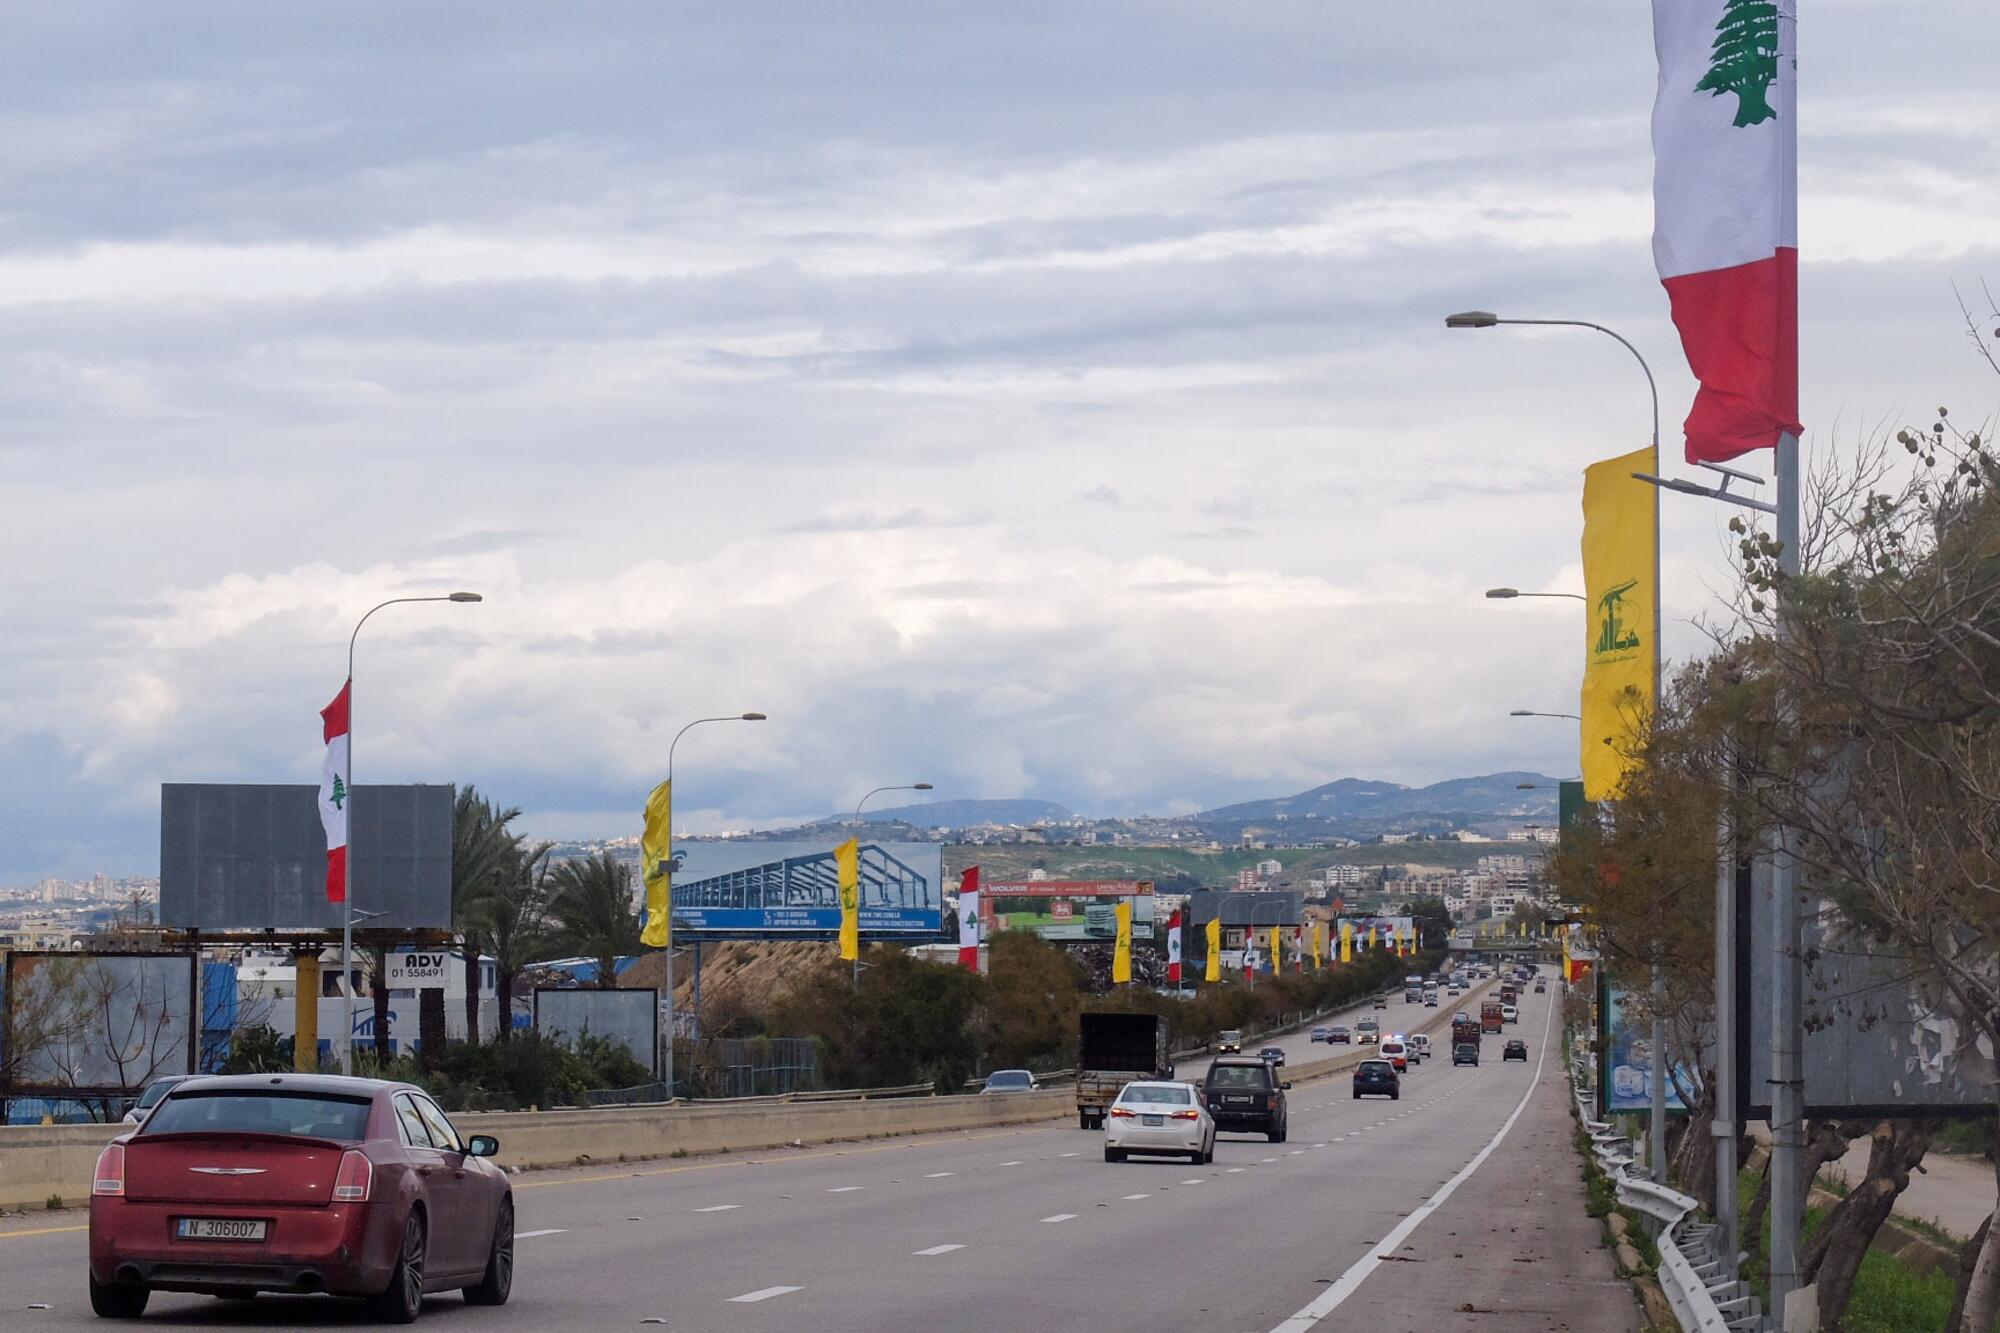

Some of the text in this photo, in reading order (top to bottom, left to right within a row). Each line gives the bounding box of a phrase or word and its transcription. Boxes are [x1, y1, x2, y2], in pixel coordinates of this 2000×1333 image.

[988, 883, 1028, 893] WOLVER
[405, 954, 444, 968] ADV
[391, 968, 444, 978] 01 558491
[189, 1221, 257, 1237] N 306007
